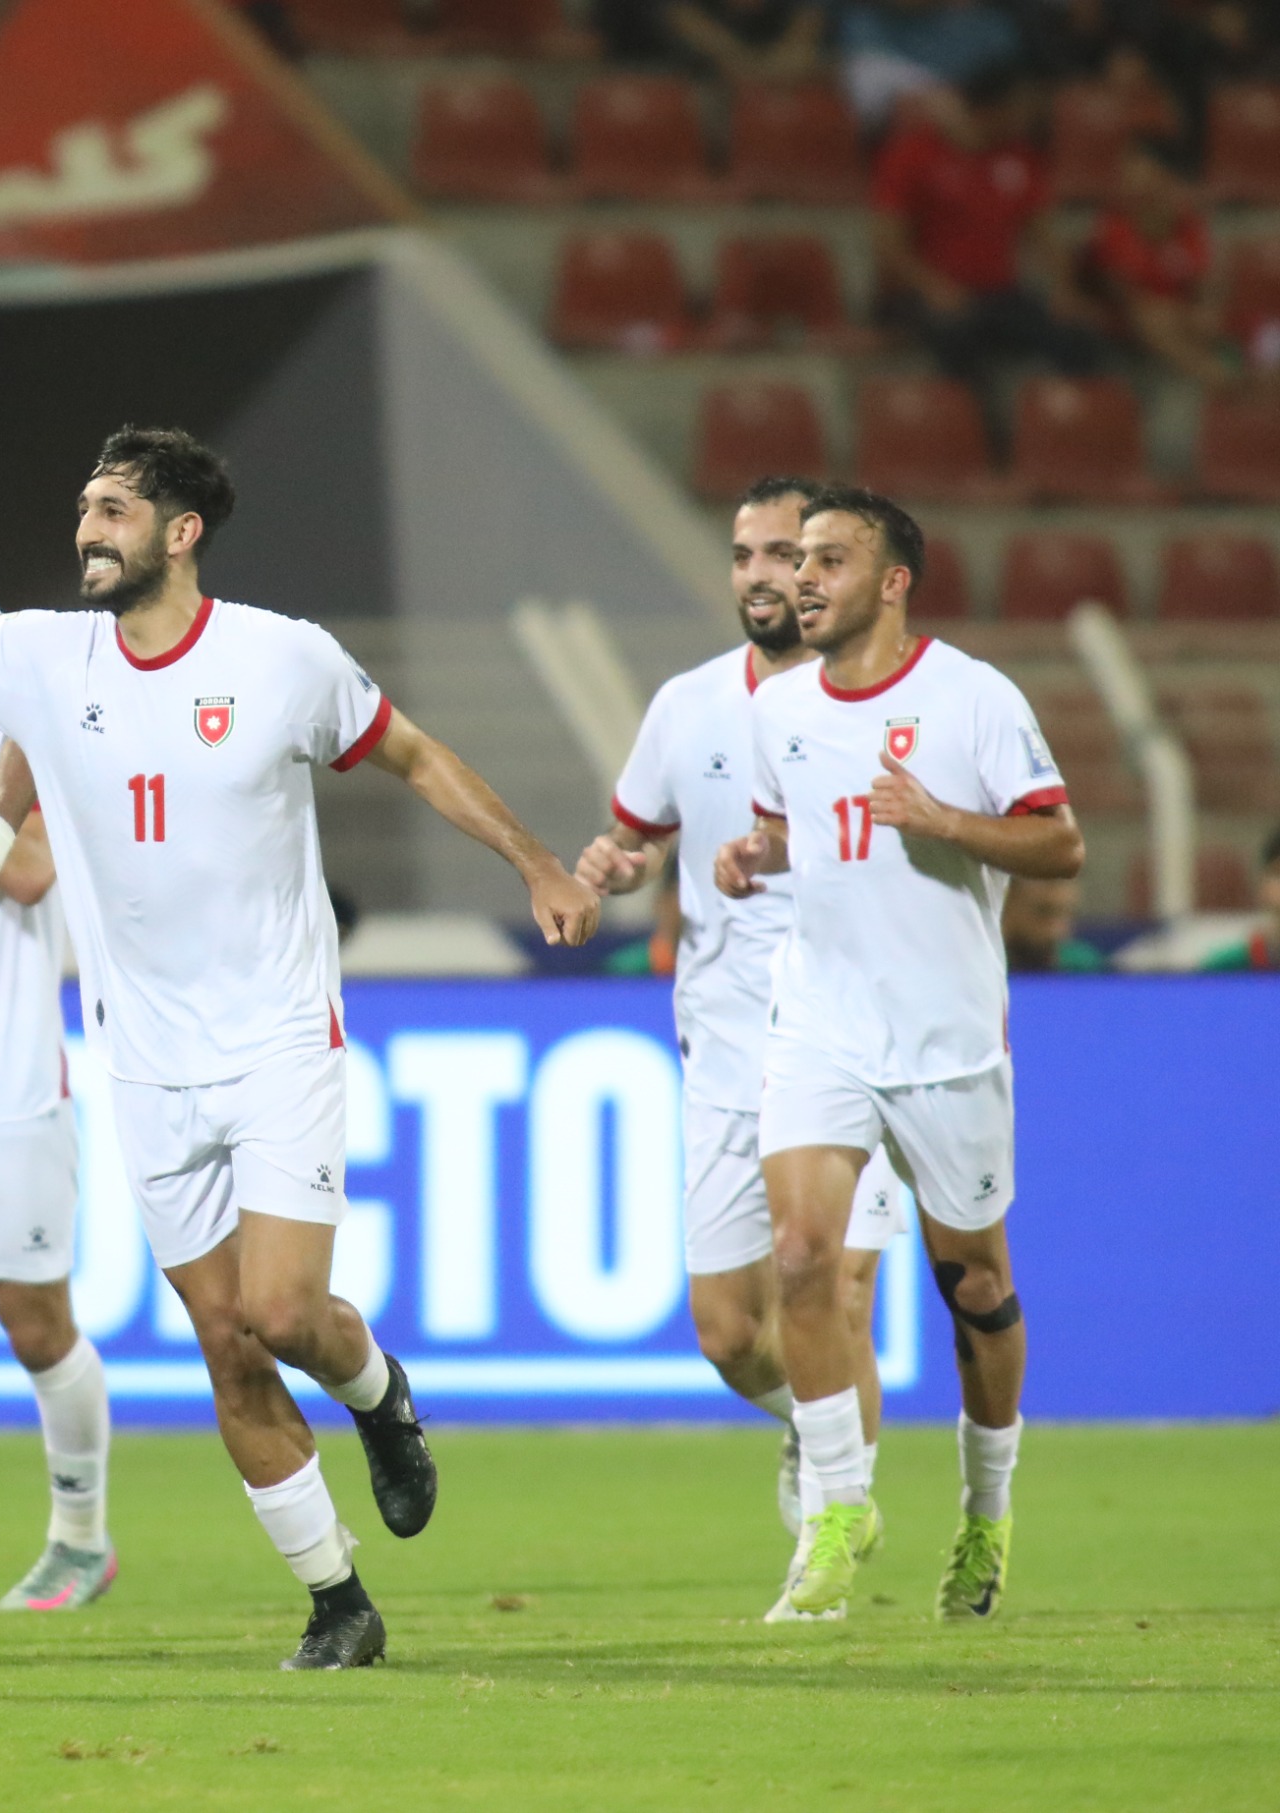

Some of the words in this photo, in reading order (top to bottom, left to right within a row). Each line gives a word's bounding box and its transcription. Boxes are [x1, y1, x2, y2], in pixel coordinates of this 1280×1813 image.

[198, 697, 230, 706] JORDAN
[127, 773, 165, 843] 11
[832, 795, 872, 863] 17
[310, 1183, 335, 1194] KELME
